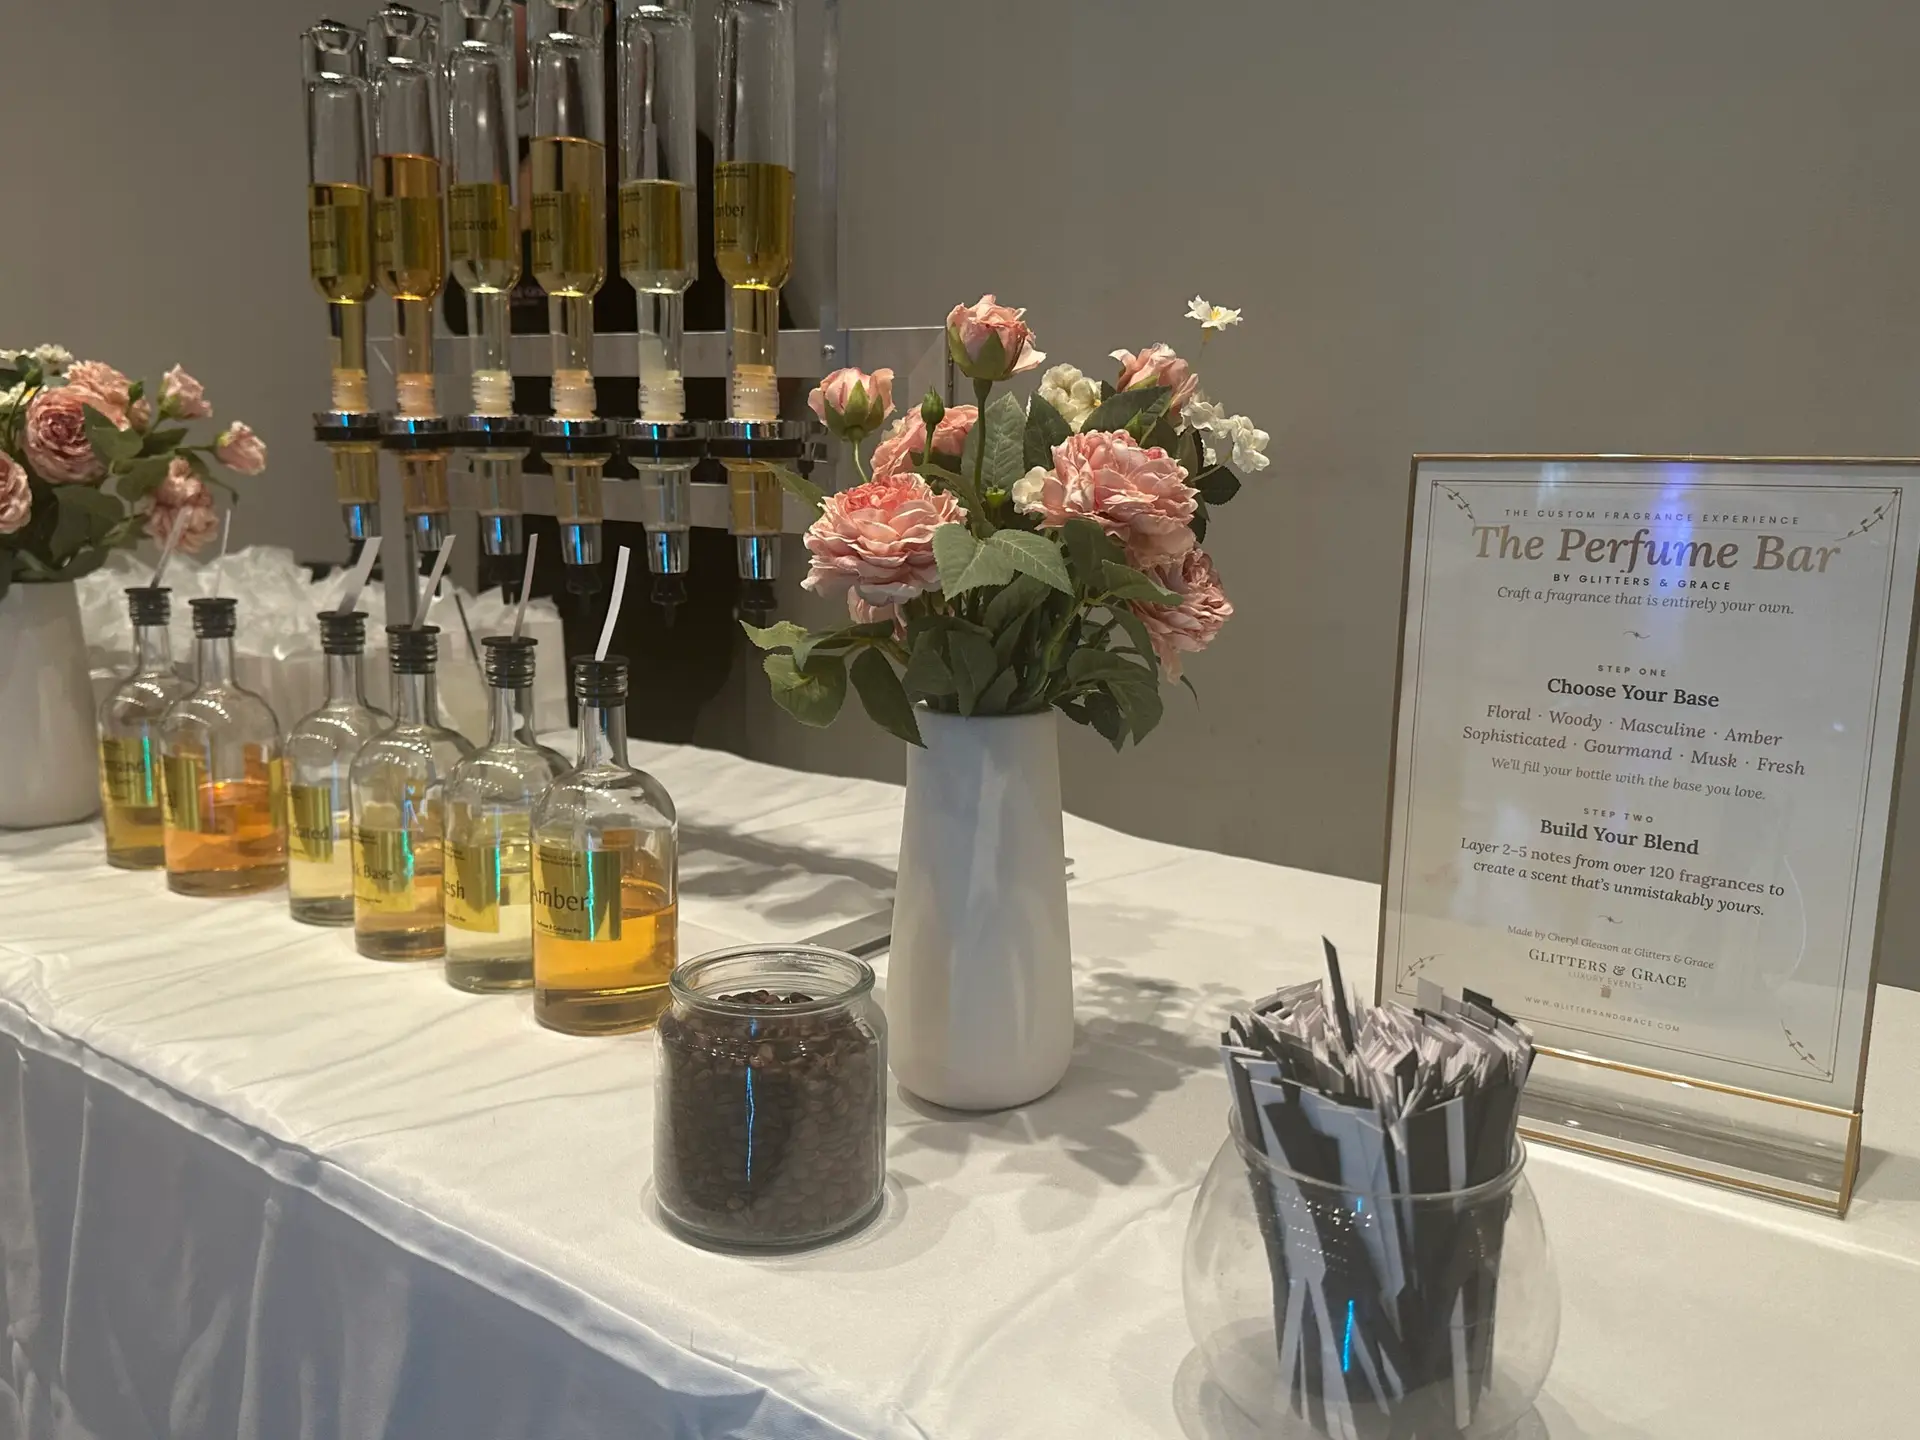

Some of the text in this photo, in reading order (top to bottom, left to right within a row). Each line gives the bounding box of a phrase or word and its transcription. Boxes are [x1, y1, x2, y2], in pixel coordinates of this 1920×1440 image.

[1505, 509, 1799, 525] THE CUSTOM FRAGRANCE EXPERIENCE
[1471, 524, 1841, 573] The Perfume Bar
[1497, 586, 1794, 614] Craft a fragrance that is entirely your own.
[1553, 573, 1730, 590] BY GLITTERS & GRACE
[1598, 664, 1667, 677] STEP ONE
[1547, 678, 1719, 707] Choose Your Base
[1487, 704, 1783, 746] Floral Woody Masculine Amber
[1463, 726, 1805, 776] Sophisticated Gourmand Musk Fresh
[1492, 757, 1766, 800] We'll fill your bottle with the base you love.
[1584, 808, 1653, 823] STEP TWO
[1540, 819, 1699, 855] Build Your Blend
[1461, 837, 1499, 854] Layer
[1531, 849, 1570, 864] notes
[1573, 854, 1609, 870] from
[1613, 861, 1645, 875] over
[1650, 866, 1674, 880] 120
[1679, 869, 1764, 893] fragrances
[1769, 884, 1785, 896] to
[1473, 861, 1515, 876] create
[1518, 868, 1527, 878] a
[1531, 869, 1567, 884] scent
[1614, 882, 1714, 911] unmistakably
[1717, 899, 1764, 916] yours.
[1507, 925, 1715, 969] Made by Cheryl Gleason at Glitters & Grace
[1528, 948, 1687, 988] GLITTERS & GRACE
[1568, 972, 1643, 990] LUXURY EVENTS
